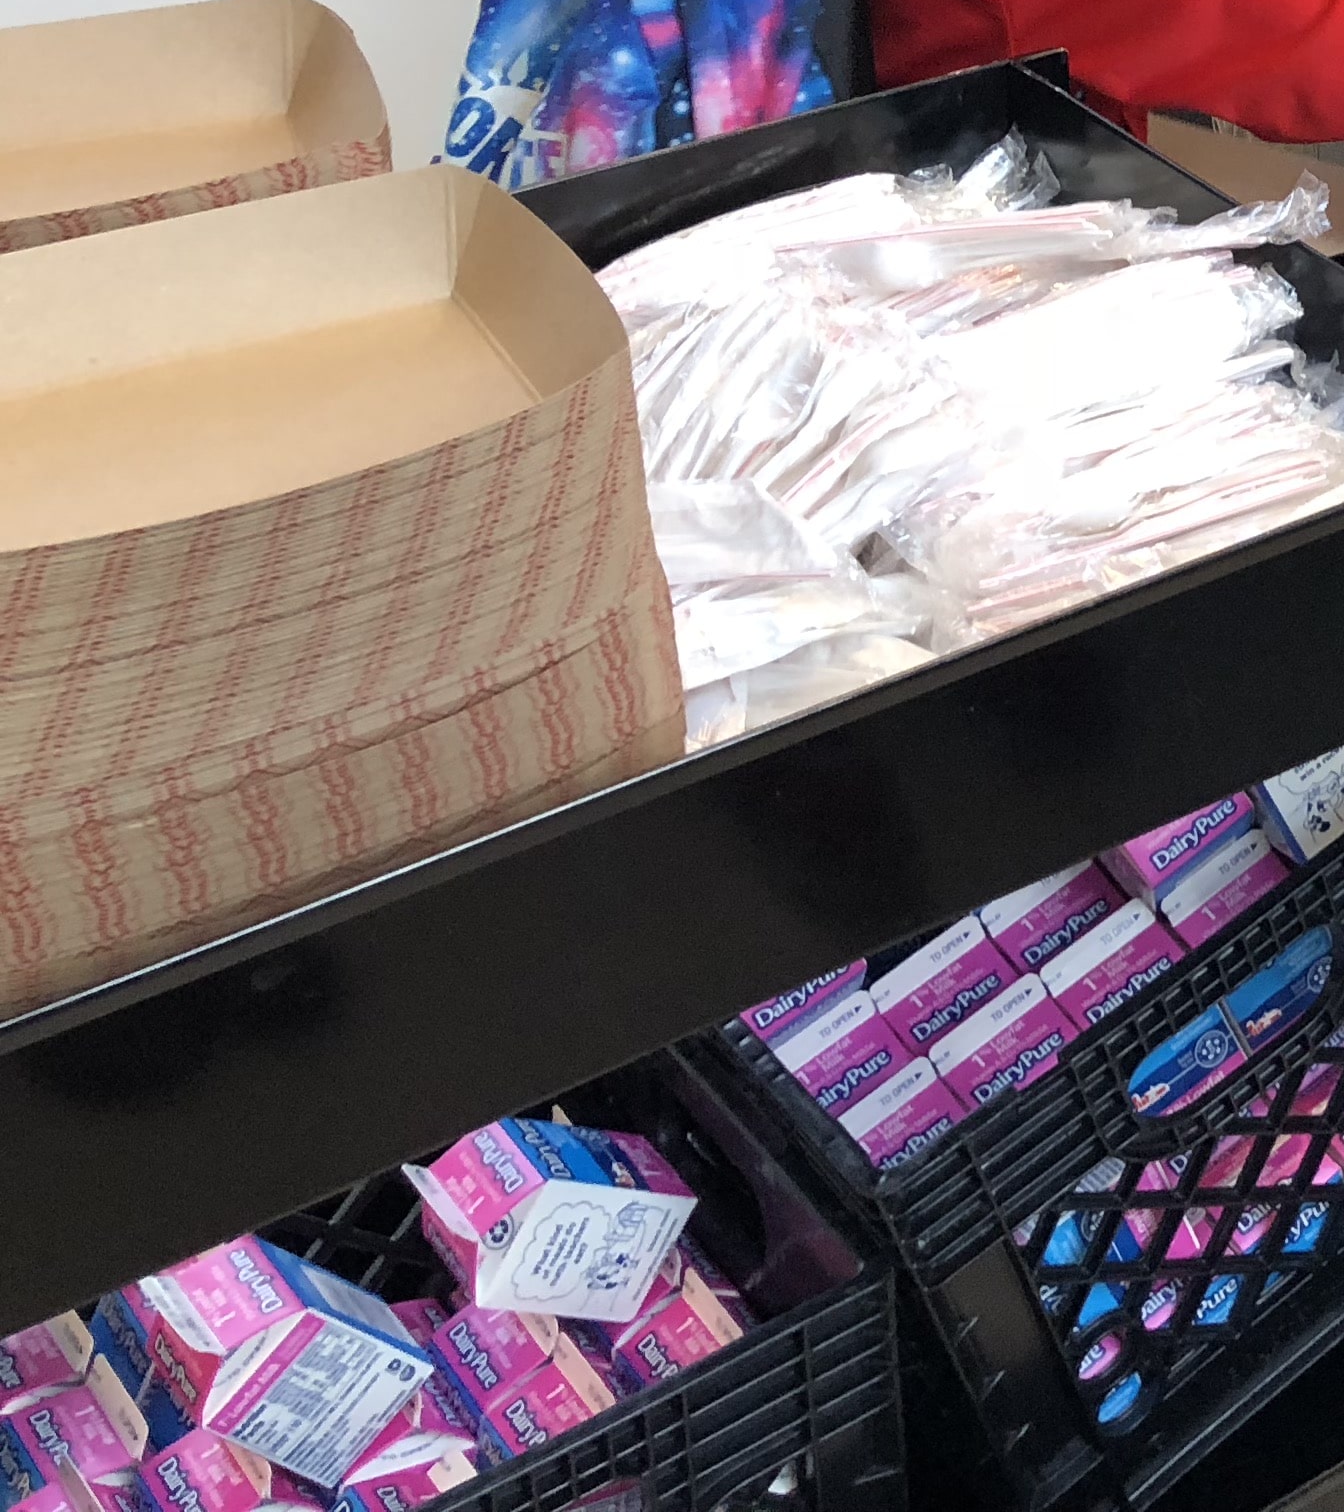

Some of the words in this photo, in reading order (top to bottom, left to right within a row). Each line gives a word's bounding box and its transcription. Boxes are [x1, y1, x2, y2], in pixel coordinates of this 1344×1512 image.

[1151, 799, 1236, 870] DairyPure
[929, 949, 941, 963] TO
[941, 934, 964, 955] OPEN
[1023, 899, 1109, 965] DairyPure
[754, 965, 850, 1028] DairyPur
[911, 973, 1000, 1041] DairyPure
[991, 1007, 1002, 1021] TO
[1002, 991, 1026, 1012] OPEN
[1086, 956, 1173, 1024] DairyPure
[818, 1025, 832, 1039] TO
[831, 1009, 856, 1030] OPEN
[816, 1050, 891, 1108] airyPure
[879, 1093, 892, 1107] TO
[892, 1077, 916, 1098] OPEN
[973, 1032, 1064, 1104] DairyPure
[473, 1131, 524, 1194] DairyPure
[880, 1117, 951, 1170] airyPure
[230, 1250, 284, 1314] DairyPure
[450, 1321, 498, 1389] DairyPure
[637, 1333, 679, 1379] DairyP
[504, 1399, 548, 1446] DairyP
